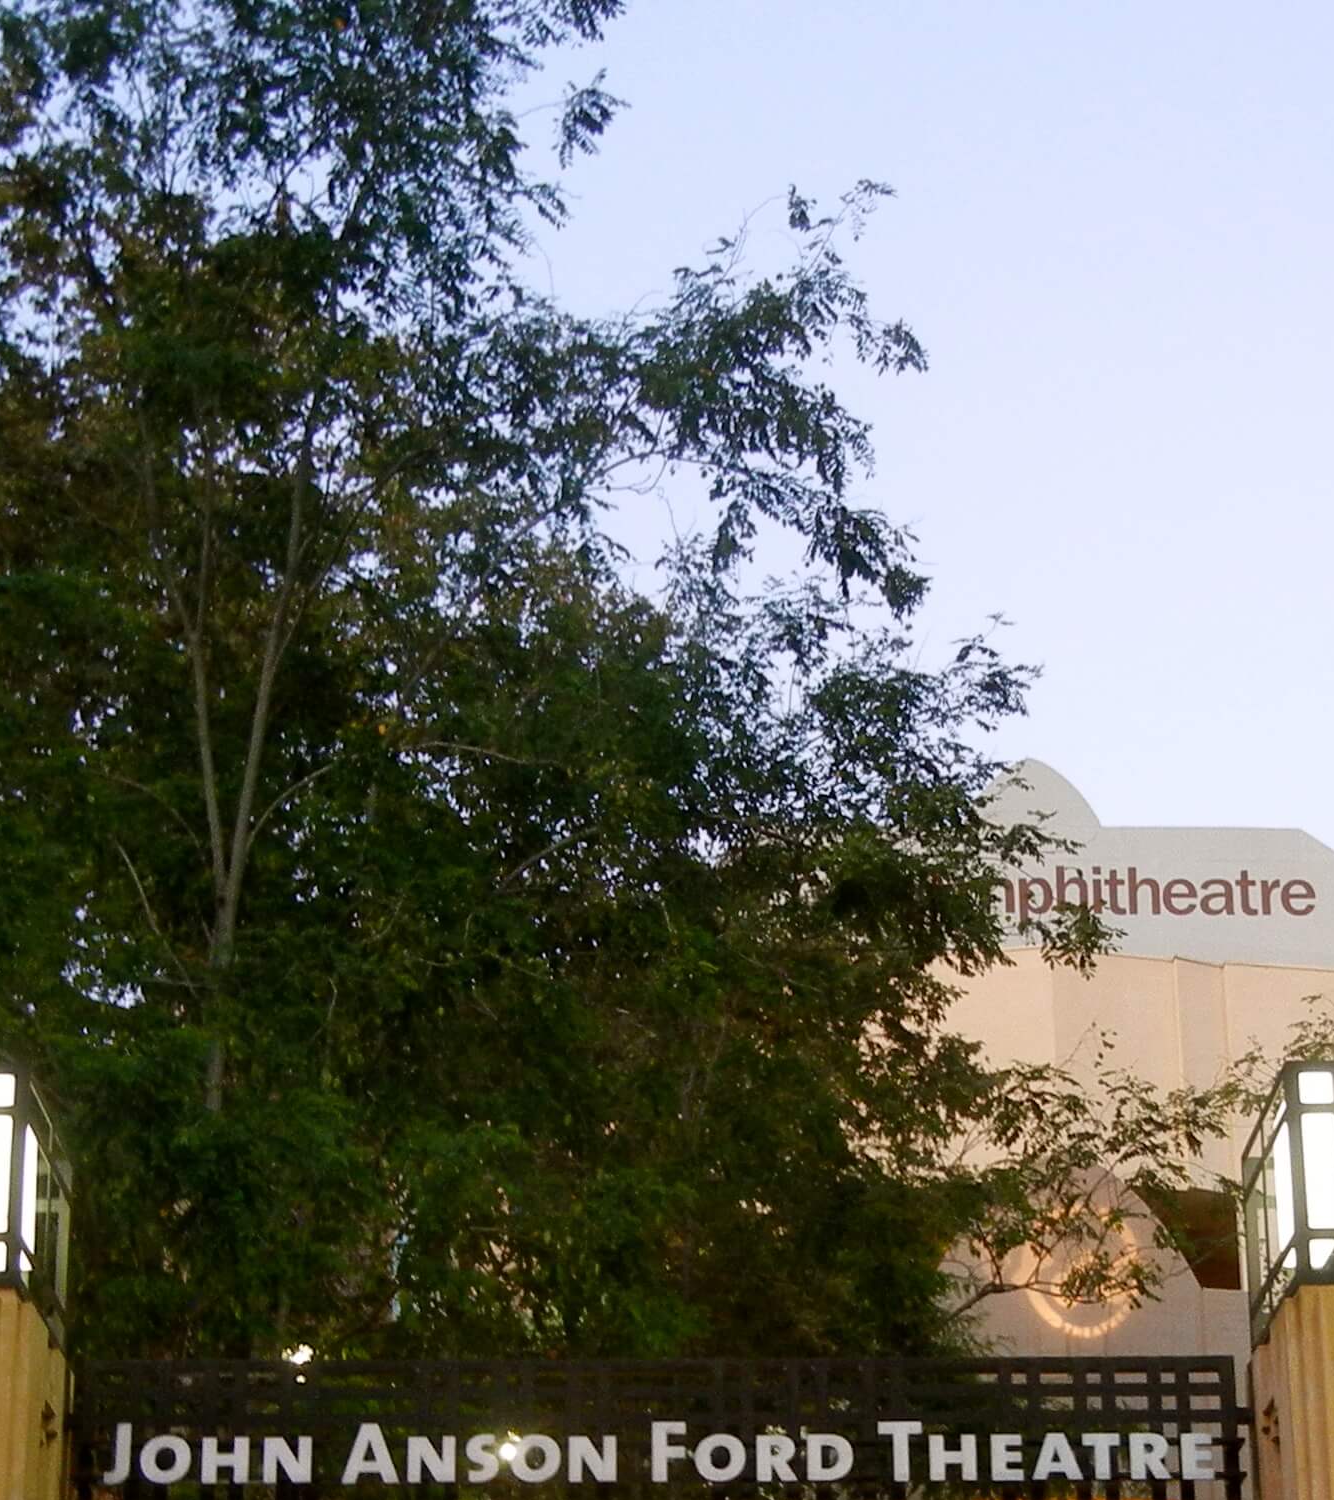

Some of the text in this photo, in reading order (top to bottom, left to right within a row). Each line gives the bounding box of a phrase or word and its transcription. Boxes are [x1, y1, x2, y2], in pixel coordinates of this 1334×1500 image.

[103, 1420, 1215, 1485] JOHN ANSON FORD THEATRE
